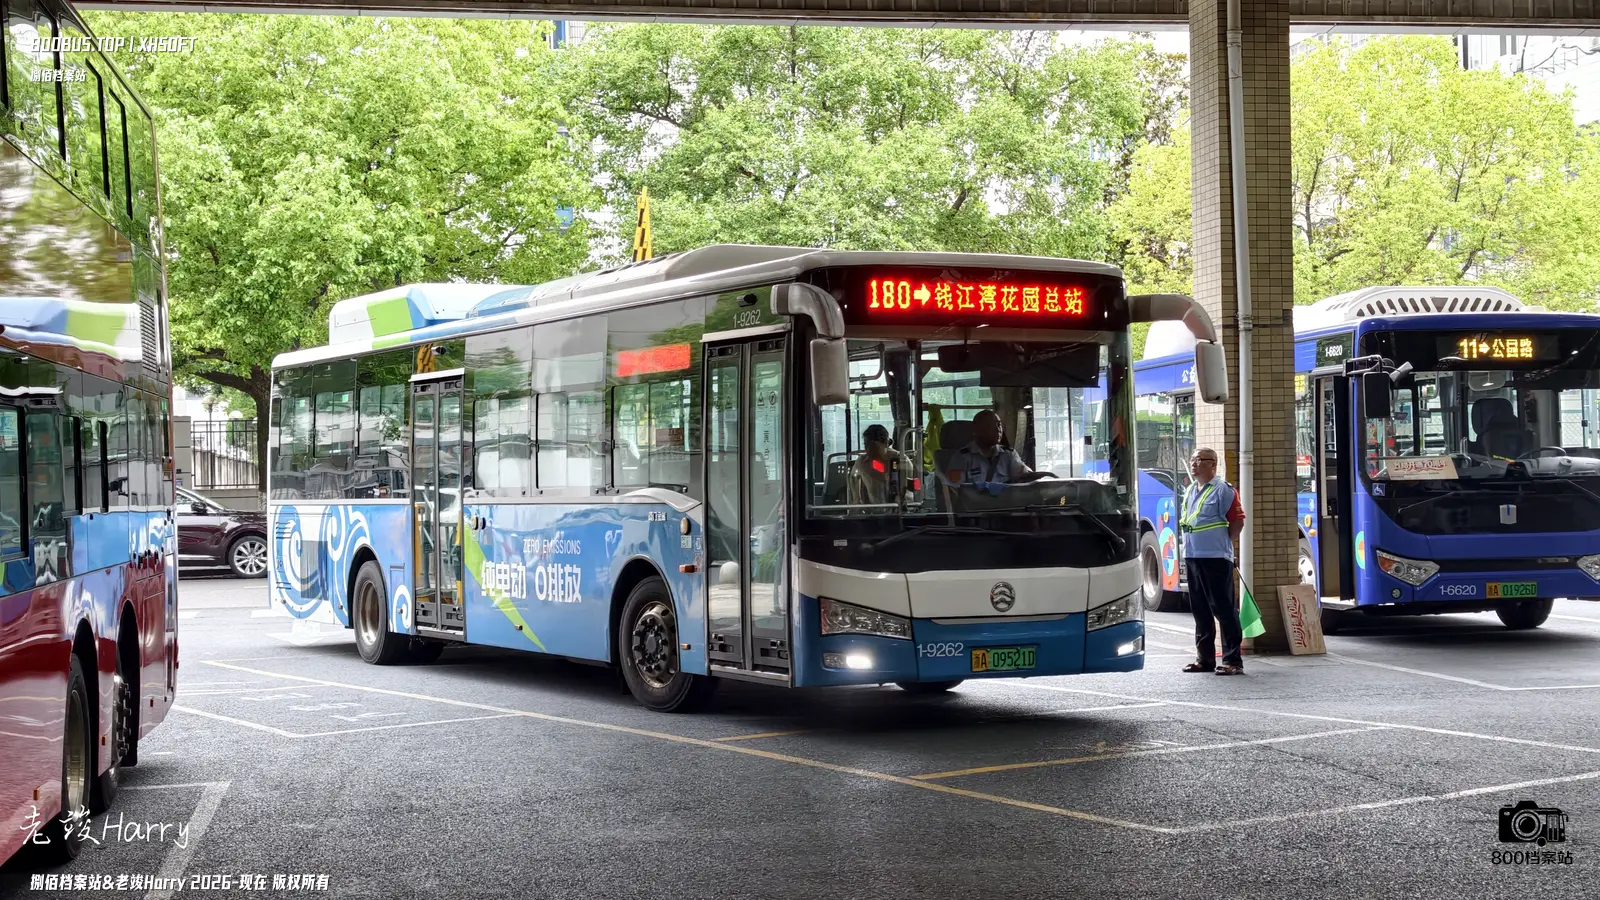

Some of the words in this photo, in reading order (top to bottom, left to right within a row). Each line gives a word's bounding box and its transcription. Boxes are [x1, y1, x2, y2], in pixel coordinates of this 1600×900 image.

[870, 279, 911, 309] 180
[934, 282, 1084, 315] 钱江湾花园总站
[733, 309, 761, 328] 1-9262
[1325, 345, 1343, 357] 1-6620
[1459, 338, 1478, 359] 11
[1492, 338, 1534, 358] 公园路
[523, 538, 540, 554] ZERO
[542, 539, 581, 555] EMISSIONS
[481, 560, 527, 599] 纯电动
[1440, 585, 1477, 596] 1-6620
[917, 642, 964, 658] 1-9262
